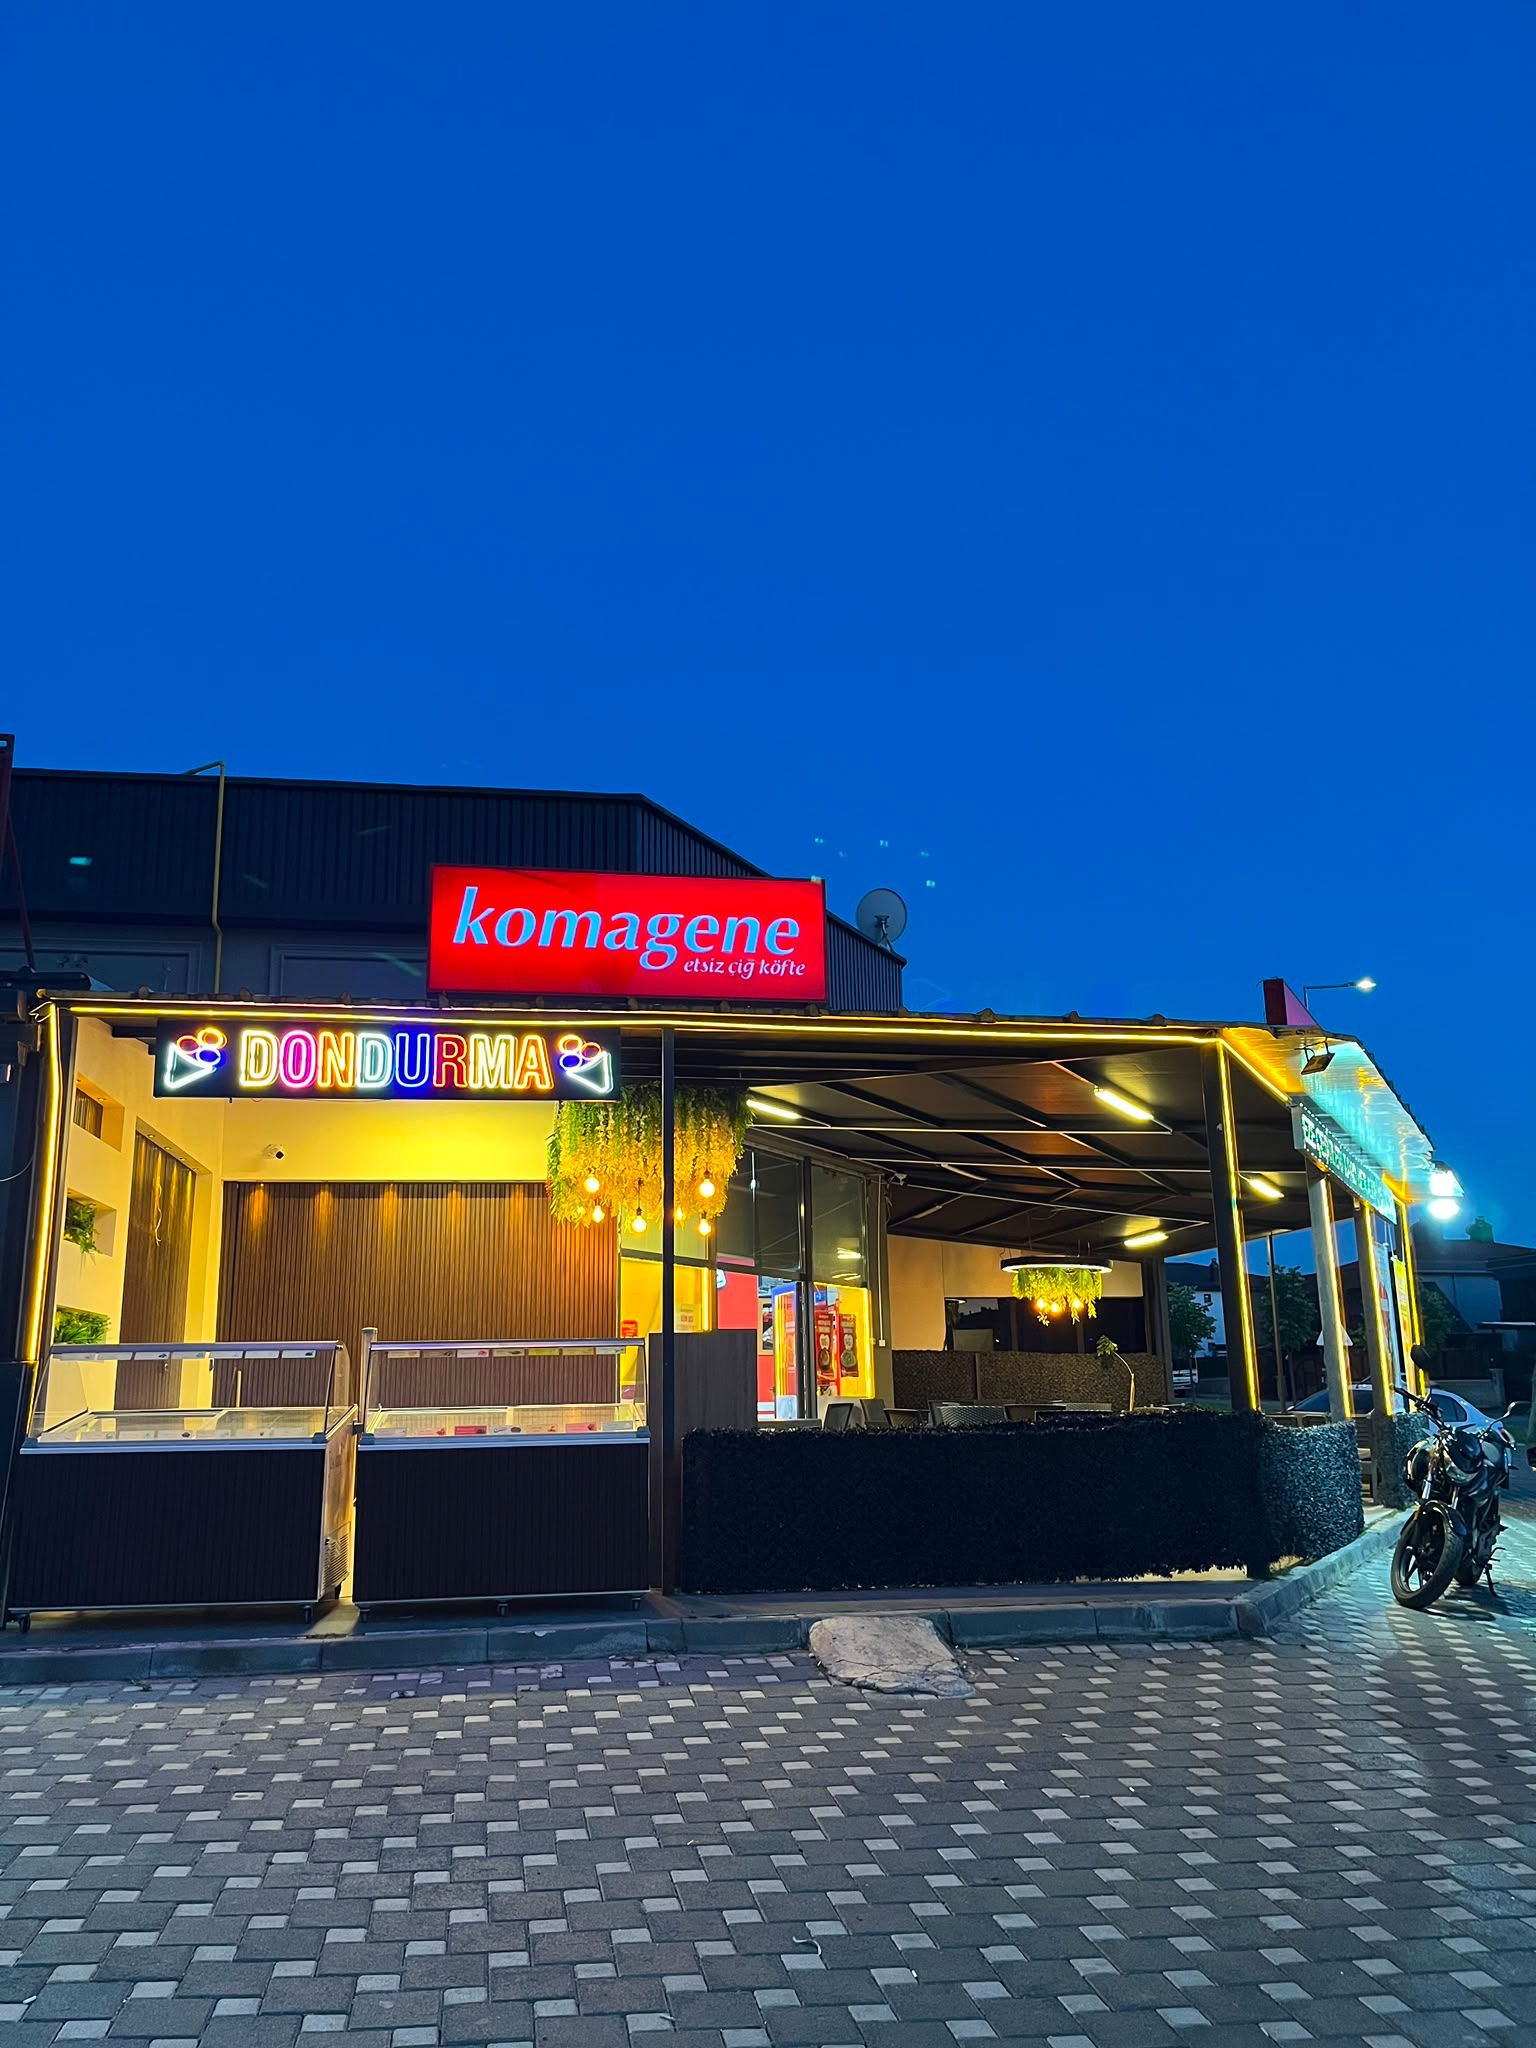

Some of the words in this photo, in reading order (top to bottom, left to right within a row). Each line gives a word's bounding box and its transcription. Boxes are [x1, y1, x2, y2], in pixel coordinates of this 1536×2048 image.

[453, 885, 800, 971] komagene
[683, 957, 725, 974] etsiz
[727, 957, 755, 980] çiğ
[758, 959, 806, 977] köfte
[239, 1029, 554, 1090] DONDURMA
